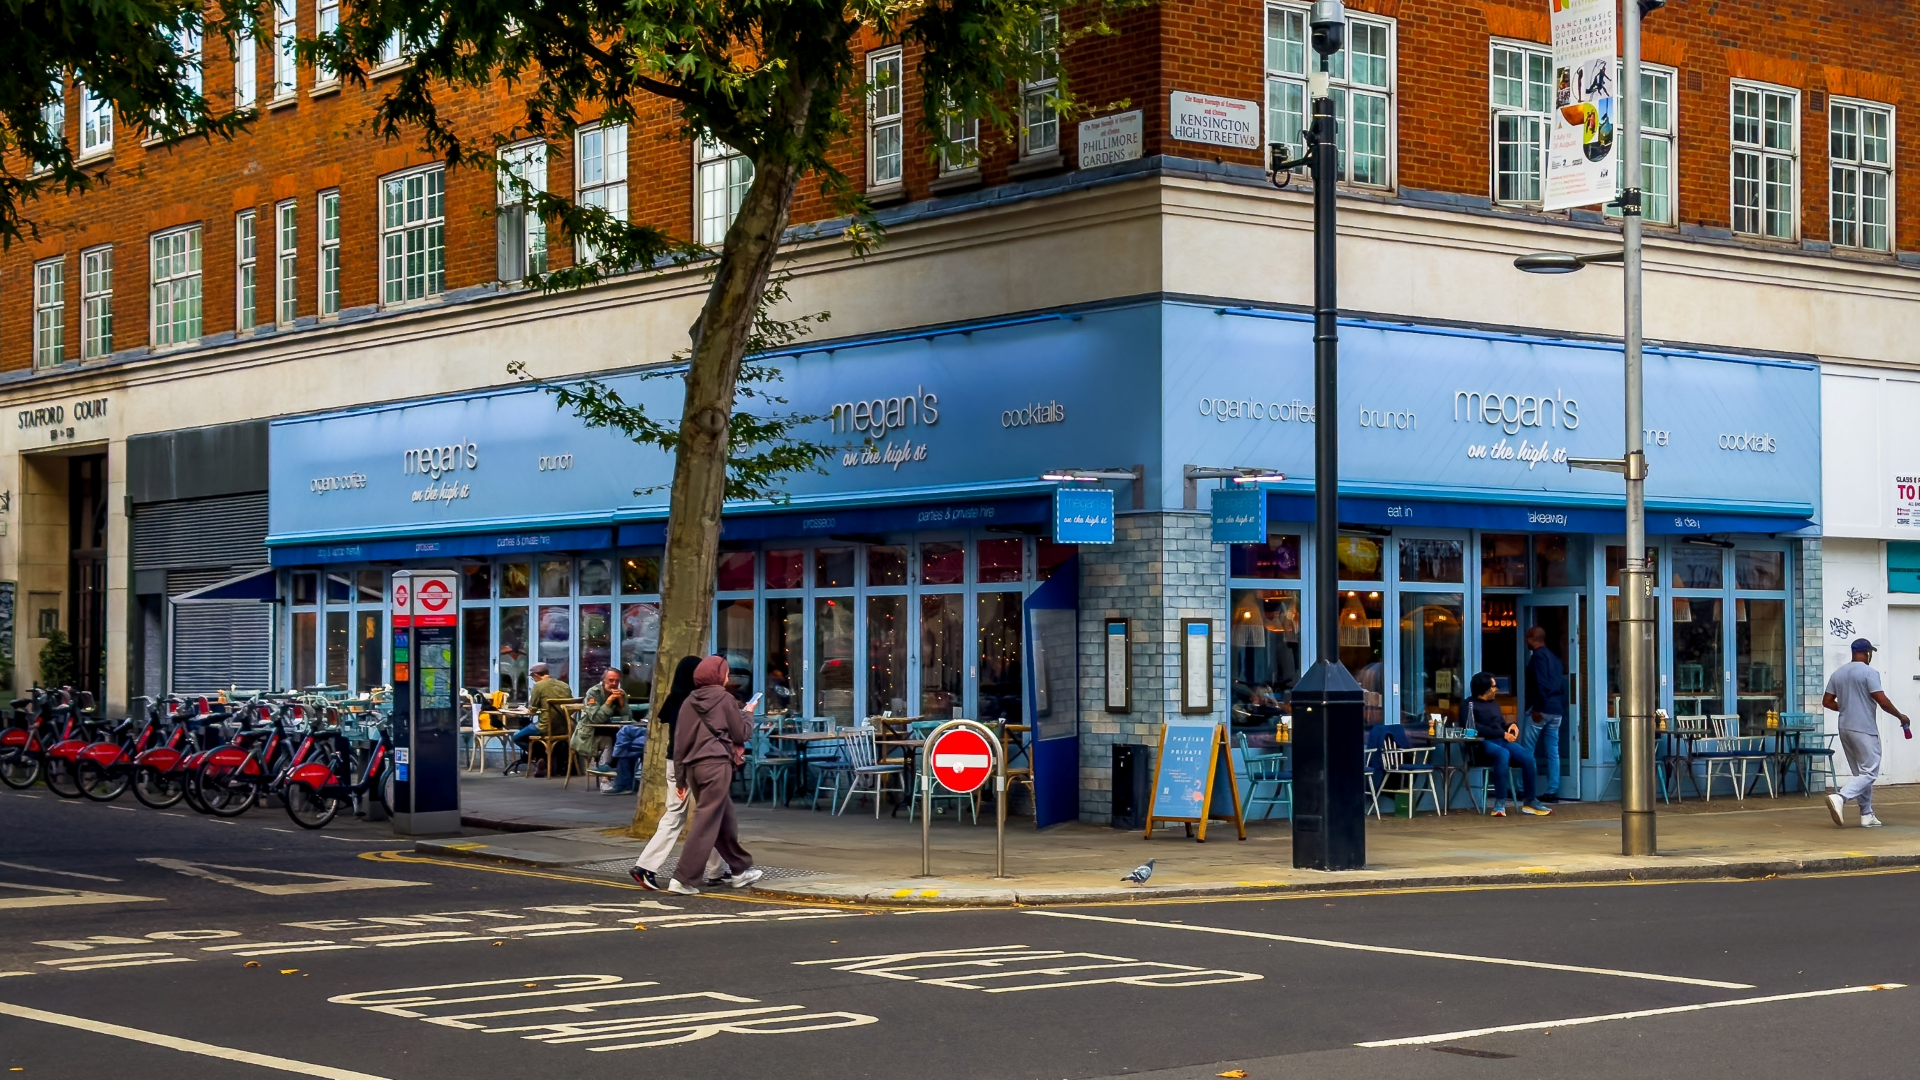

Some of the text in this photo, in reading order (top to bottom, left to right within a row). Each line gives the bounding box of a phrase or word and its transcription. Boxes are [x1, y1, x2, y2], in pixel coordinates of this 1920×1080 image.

[1555, 19, 1582, 31] DANCE
[1585, 11, 1611, 23] MUSIC
[1555, 27, 1612, 47] FILM CIRCUS
[1175, 125, 1200, 140] HIGH
[1180, 113, 1250, 133] KENSINGTON
[1083, 132, 1138, 154] PHILLIMORE
[1083, 148, 1126, 167] GARDENS
[18, 397, 108, 429] STAFFORD COURT
[831, 384, 939, 439] megan's
[1001, 400, 1065, 428] cocktails
[1199, 396, 1264, 422] organic
[1359, 404, 1417, 431] brunch
[1454, 387, 1580, 436] megan's
[1643, 428, 1671, 446] nner
[1718, 431, 1777, 453] cocktails
[404, 437, 478, 480] megan's
[539, 452, 573, 472] brunch
[842, 439, 927, 473] on the high st
[1467, 444, 1487, 459] on
[1490, 438, 1514, 461] the
[1516, 439, 1549, 471] high
[311, 478, 340, 495] organic
[412, 490, 423, 502] on
[439, 480, 459, 507] high
[1897, 484, 1916, 500] TO
[917, 508, 943, 523] parties
[952, 506, 979, 521] private
[980, 505, 995, 518] hire
[1388, 505, 1413, 517] eat in
[1528, 512, 1567, 527] takeaway
[791, 944, 1264, 993] KEEP
[326, 974, 880, 1053] CLEAR
